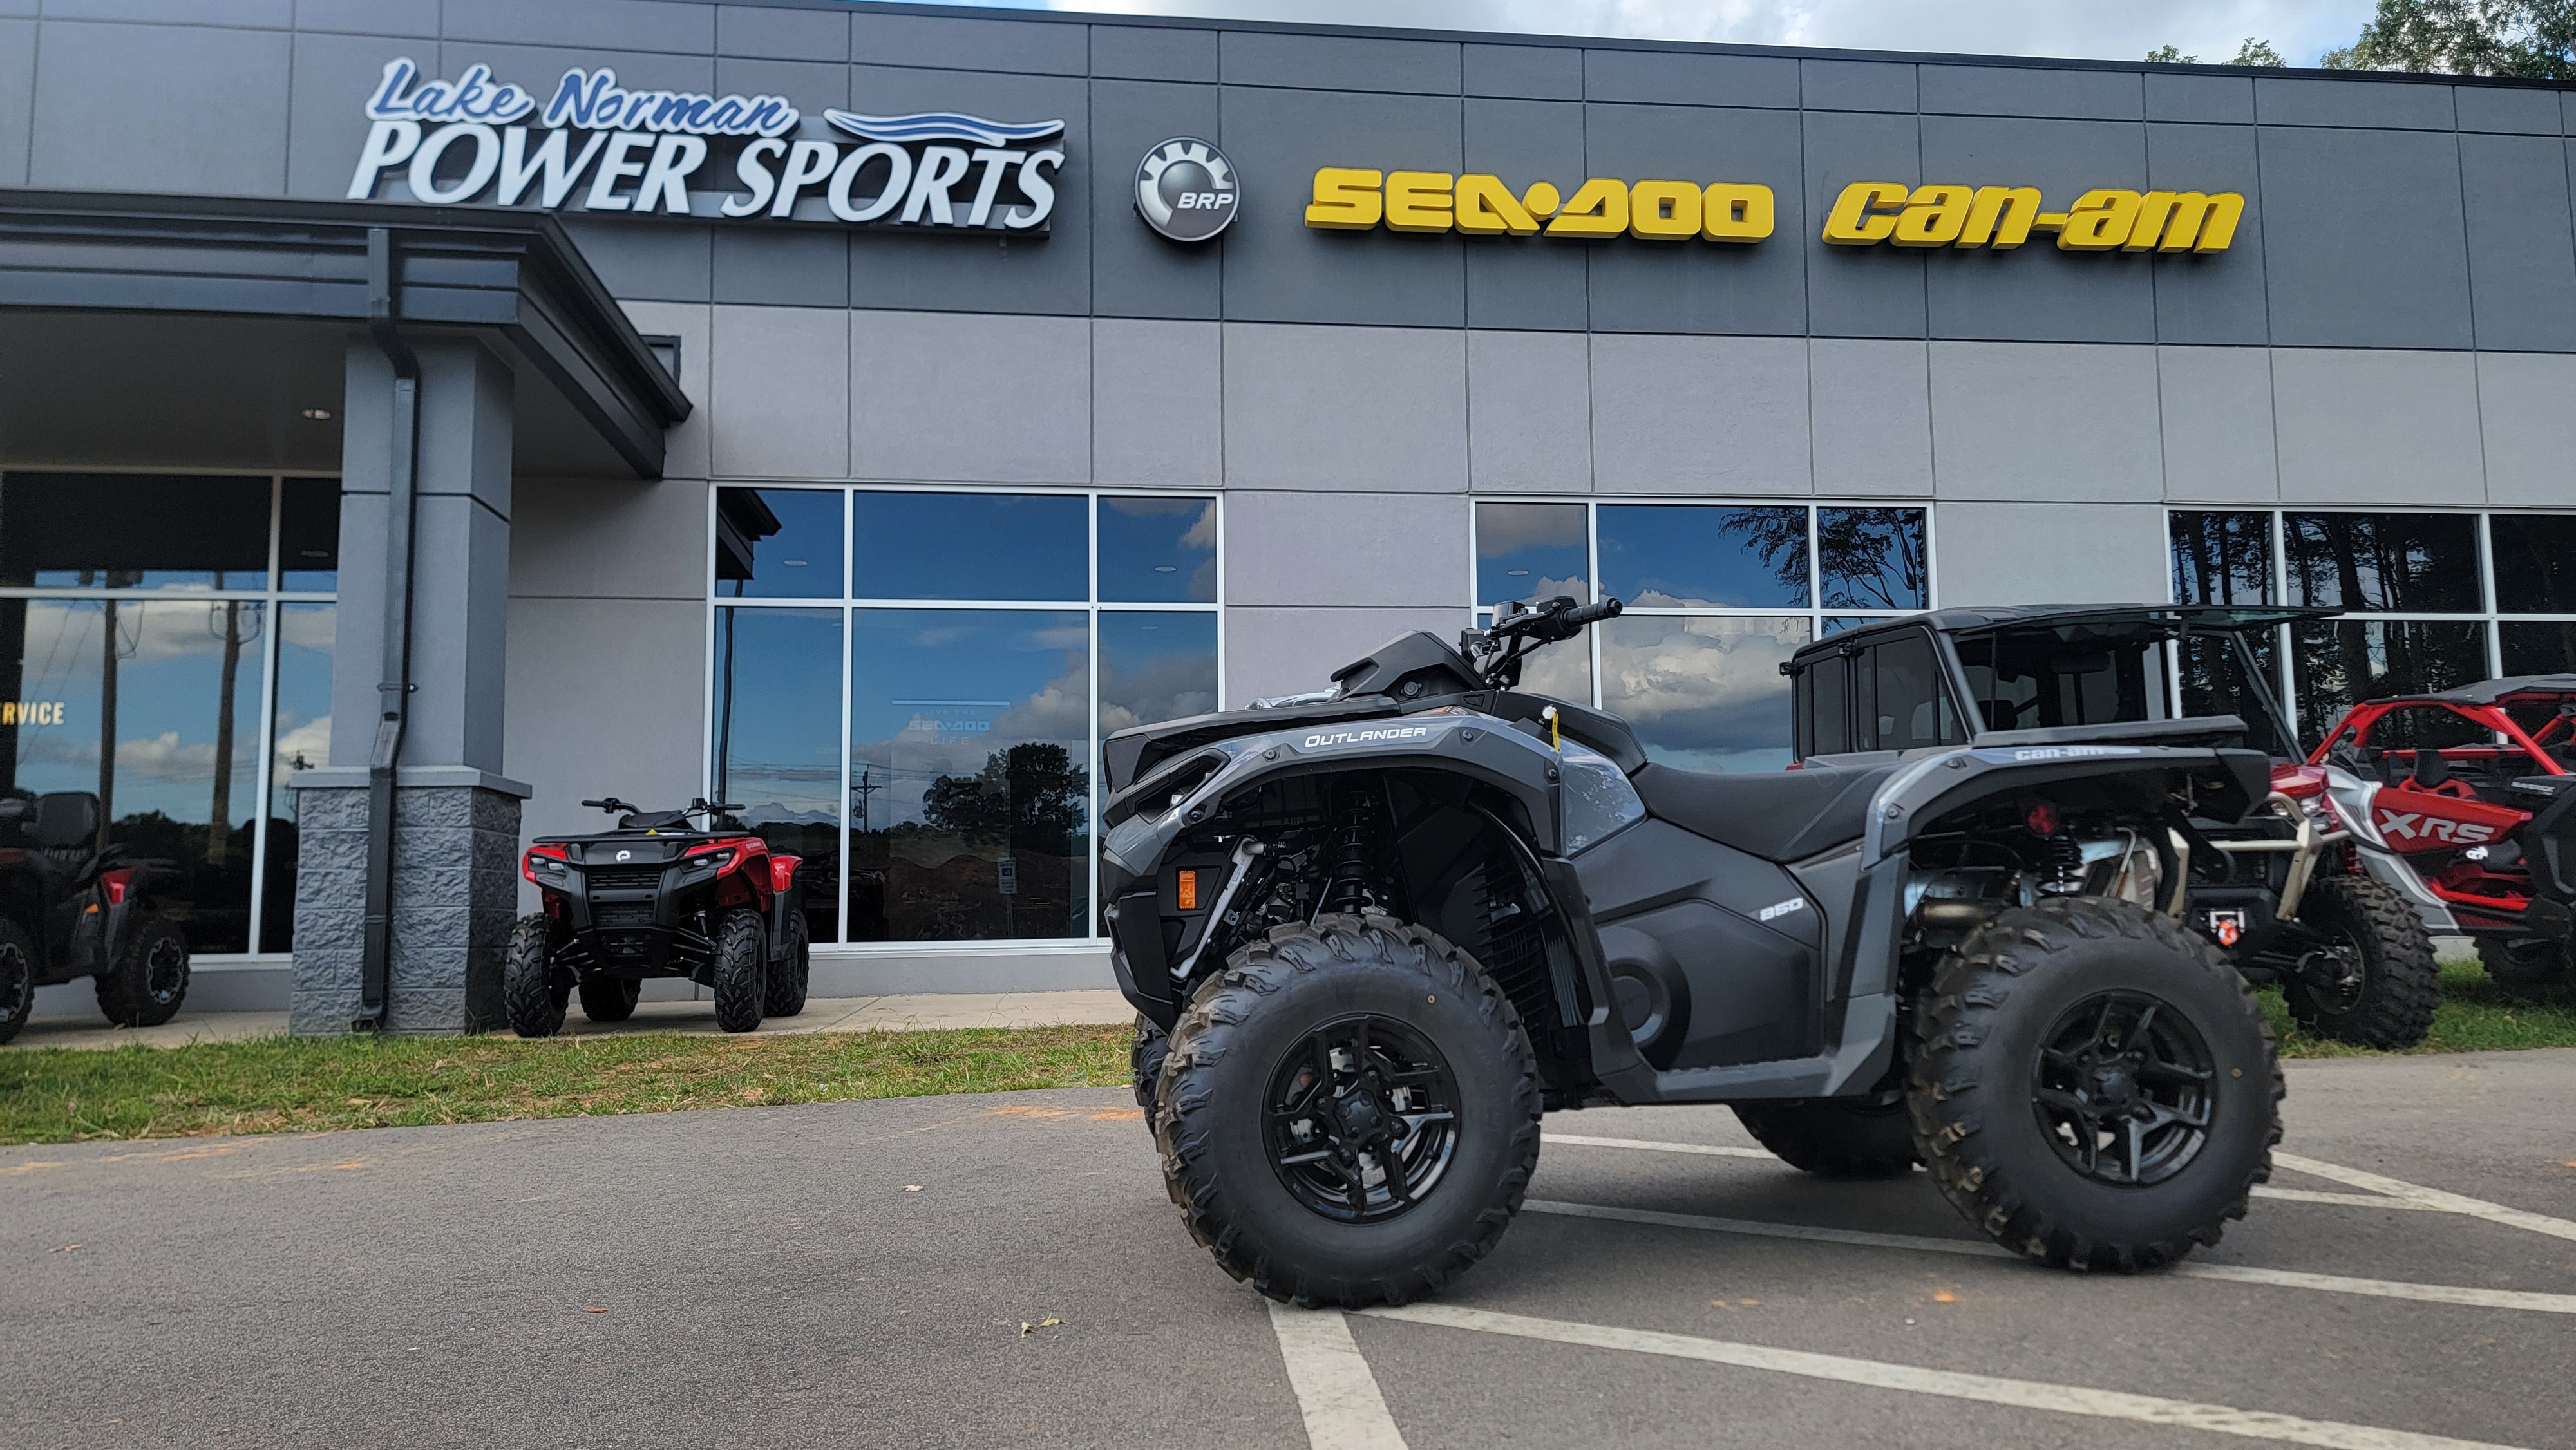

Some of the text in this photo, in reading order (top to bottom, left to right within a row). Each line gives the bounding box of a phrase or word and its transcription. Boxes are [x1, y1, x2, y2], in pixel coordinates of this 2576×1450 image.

[367, 57, 799, 137] Lake Norman
[346, 120, 1066, 229] POWER SPORTS
[1177, 191, 1235, 210] BRP
[930, 736, 969, 745] LIFE
[1305, 727, 1427, 748] OUTLANDER
[2379, 809, 2495, 844] XRS
[1759, 897, 1804, 921] 850
